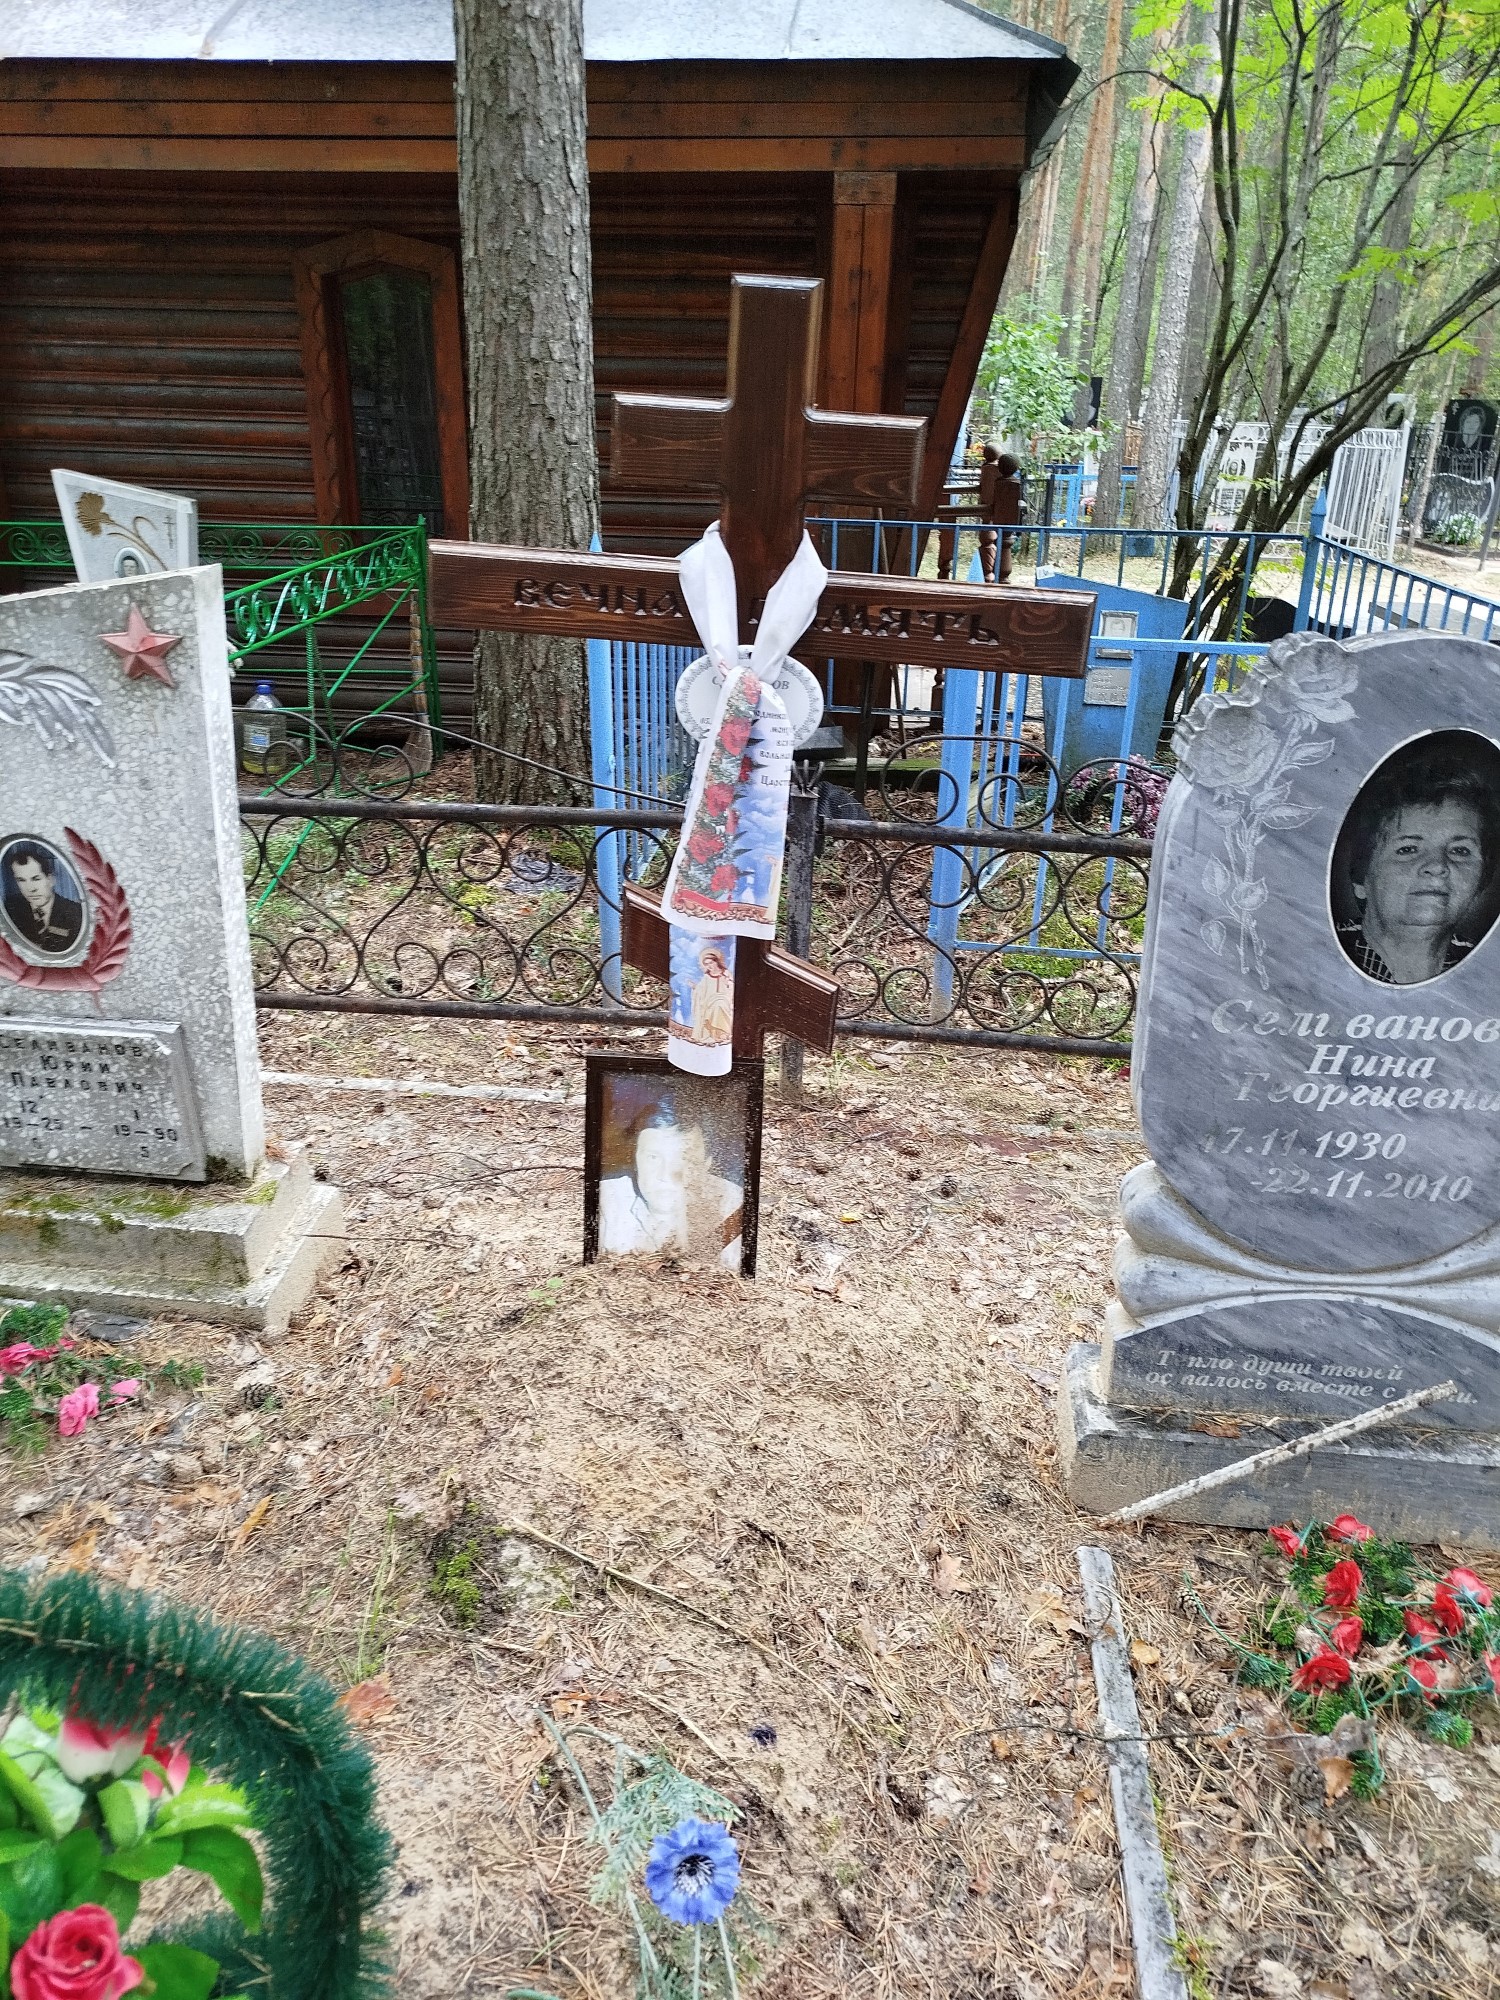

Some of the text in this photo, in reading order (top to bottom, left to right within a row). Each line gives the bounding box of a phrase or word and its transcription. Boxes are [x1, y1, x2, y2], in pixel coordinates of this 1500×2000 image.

[513, 577, 1000, 646] ВЕЧНА ПМЯТЬ
[1304, 1044, 1437, 1079] Нина
[1157, 1350, 1234, 1370] Тпло
[1242, 1353, 1313, 1376] души
[1275, 1380, 1374, 1397] вместе
[1381, 1386, 1396, 1398] с
